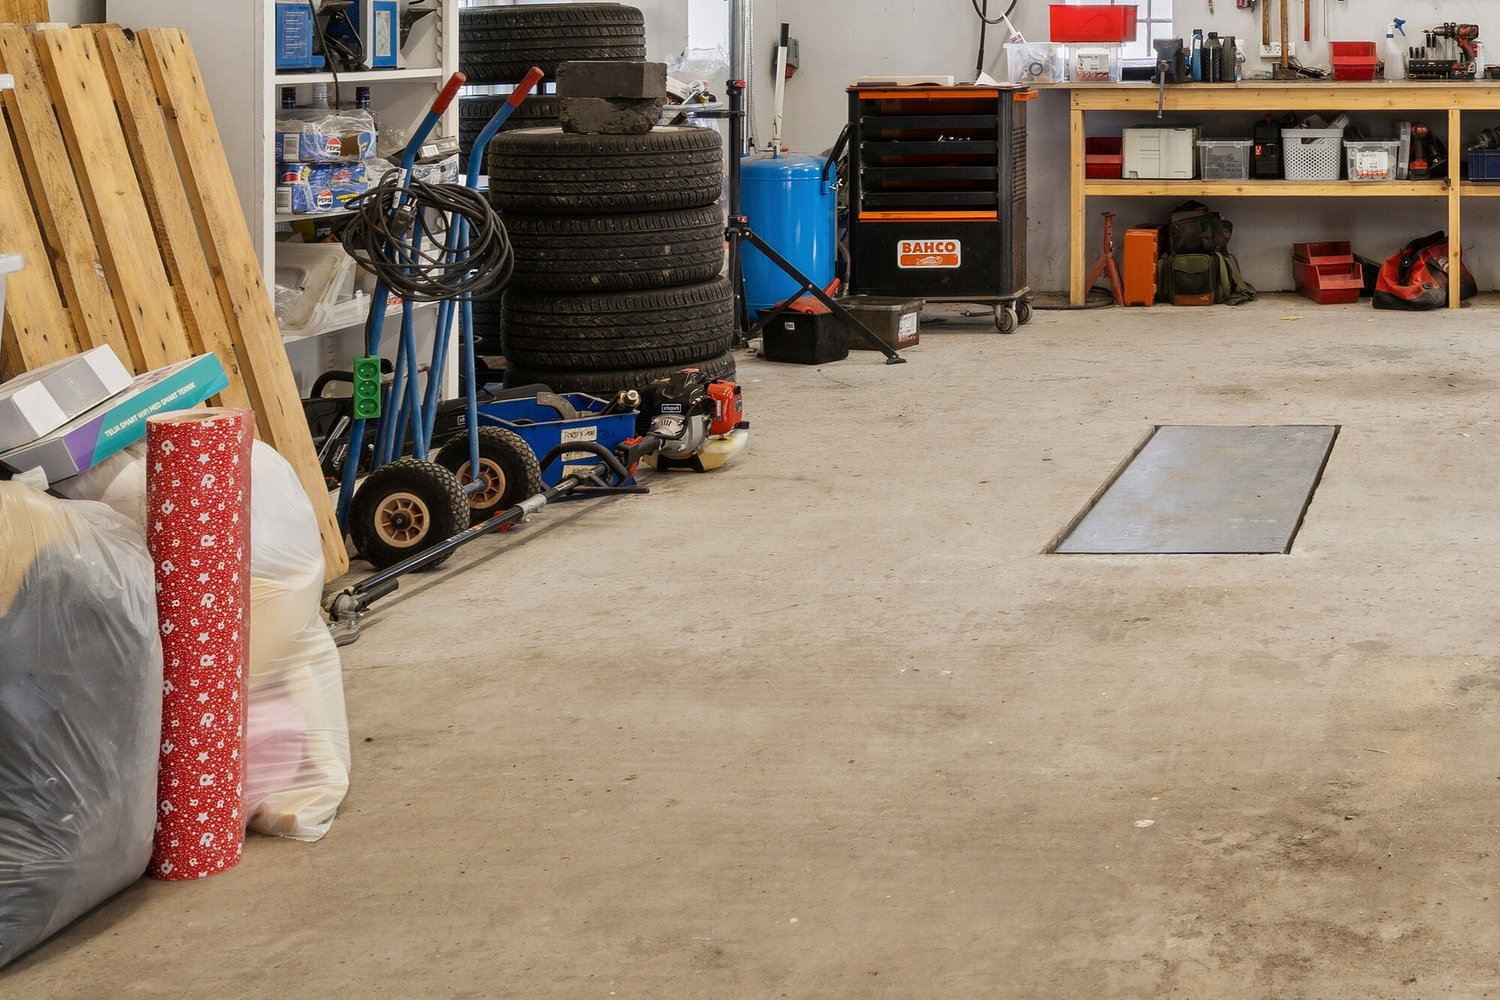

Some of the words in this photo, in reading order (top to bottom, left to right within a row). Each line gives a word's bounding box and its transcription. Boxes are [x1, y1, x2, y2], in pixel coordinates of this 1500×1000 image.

[902, 242, 956, 253] BAHCO
[104, 425, 119, 438] TELIA
[149, 402, 160, 412] MED
